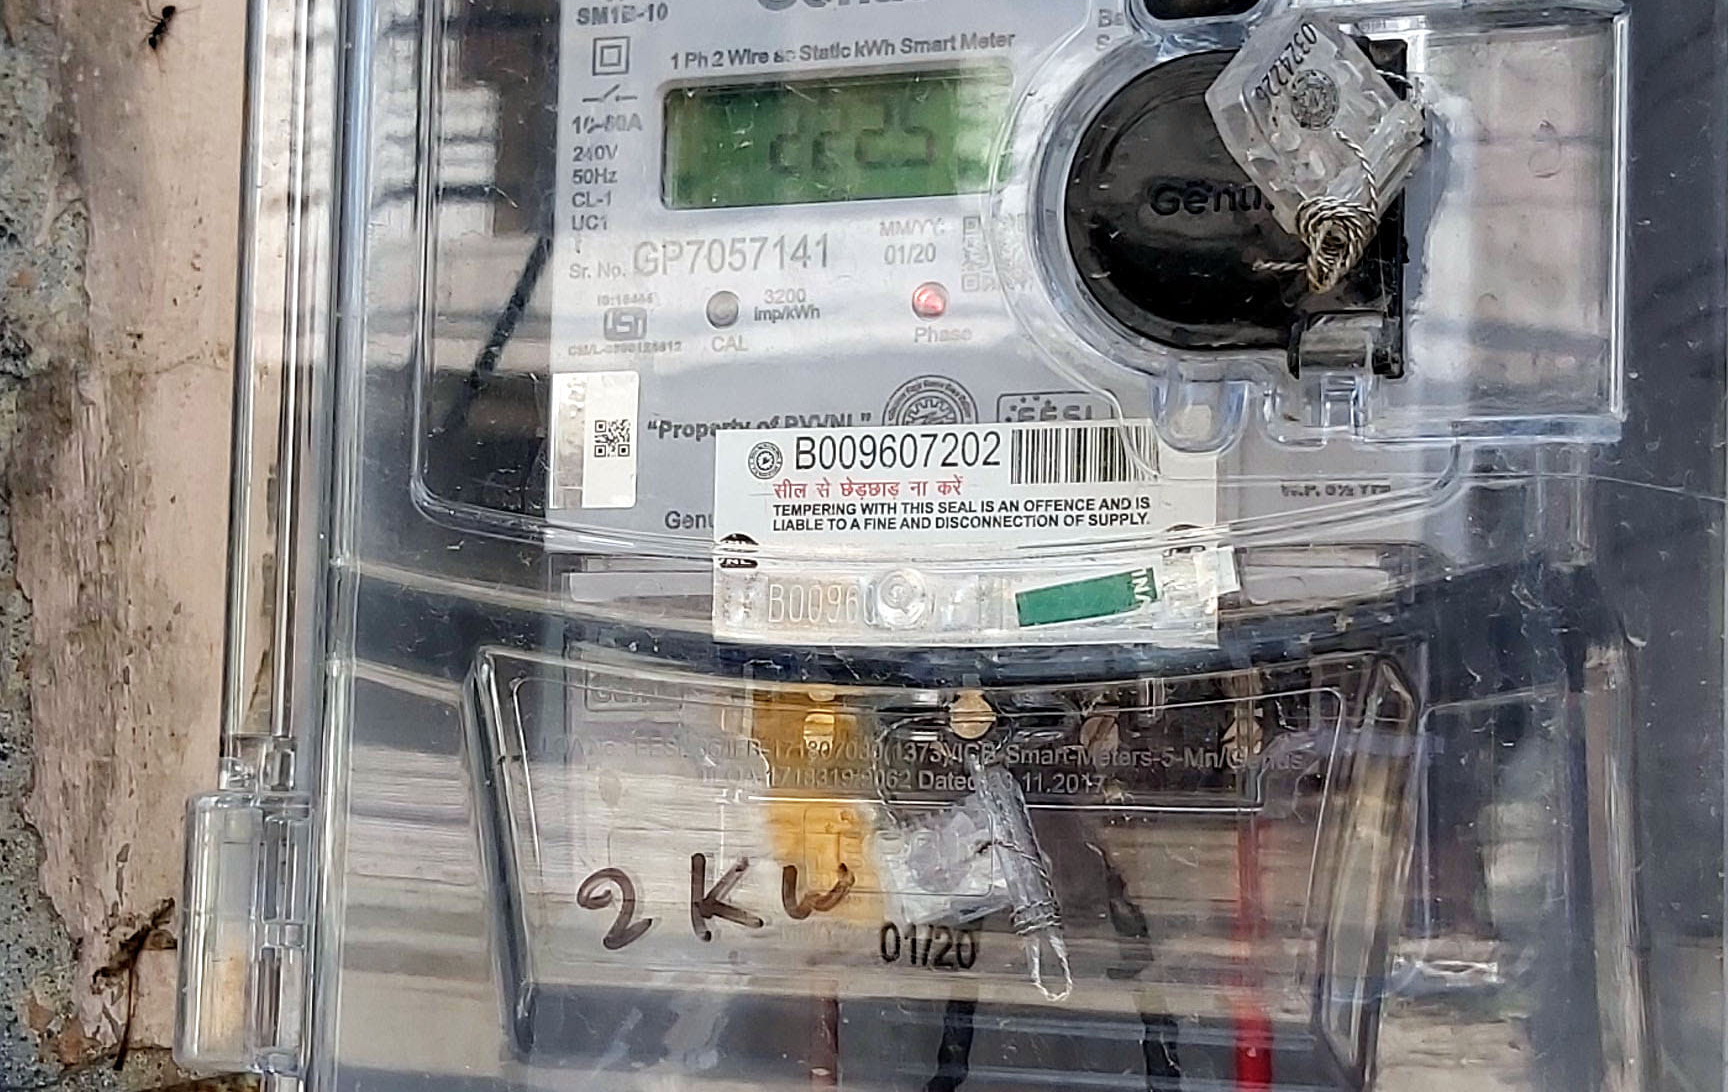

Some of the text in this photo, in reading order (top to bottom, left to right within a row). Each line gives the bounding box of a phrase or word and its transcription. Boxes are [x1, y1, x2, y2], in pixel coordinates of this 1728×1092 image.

[671, 52, 679, 70] 1
[684, 51, 709, 69] Ph
[711, 50, 725, 68] 2
[728, 48, 769, 66] Wire
[799, 42, 851, 61] Static
[853, 41, 896, 58] kWh
[899, 35, 956, 55] Smart
[959, 31, 1017, 51] Meter
[572, 167, 619, 185] 50Hz
[571, 189, 612, 208] CL-1
[1150, 178, 1276, 216] Genu
[633, 233, 829, 277] GP7057141
[884, 241, 937, 266] 01/20
[764, 288, 807, 305] 3200
[711, 335, 749, 353] CAL
[914, 325, 973, 344] Phase
[795, 431, 1001, 471] B009607202
[772, 495, 1151, 518] TEMPERING WITH THIS SEAL IS AN OFFENCE AND IS
[772, 511, 1152, 533] LIABLE TO A FINE AND DISCONNECTION OF SUPPLY.
[577, 866, 654, 951] 2
[880, 921, 978, 970] 01/20
